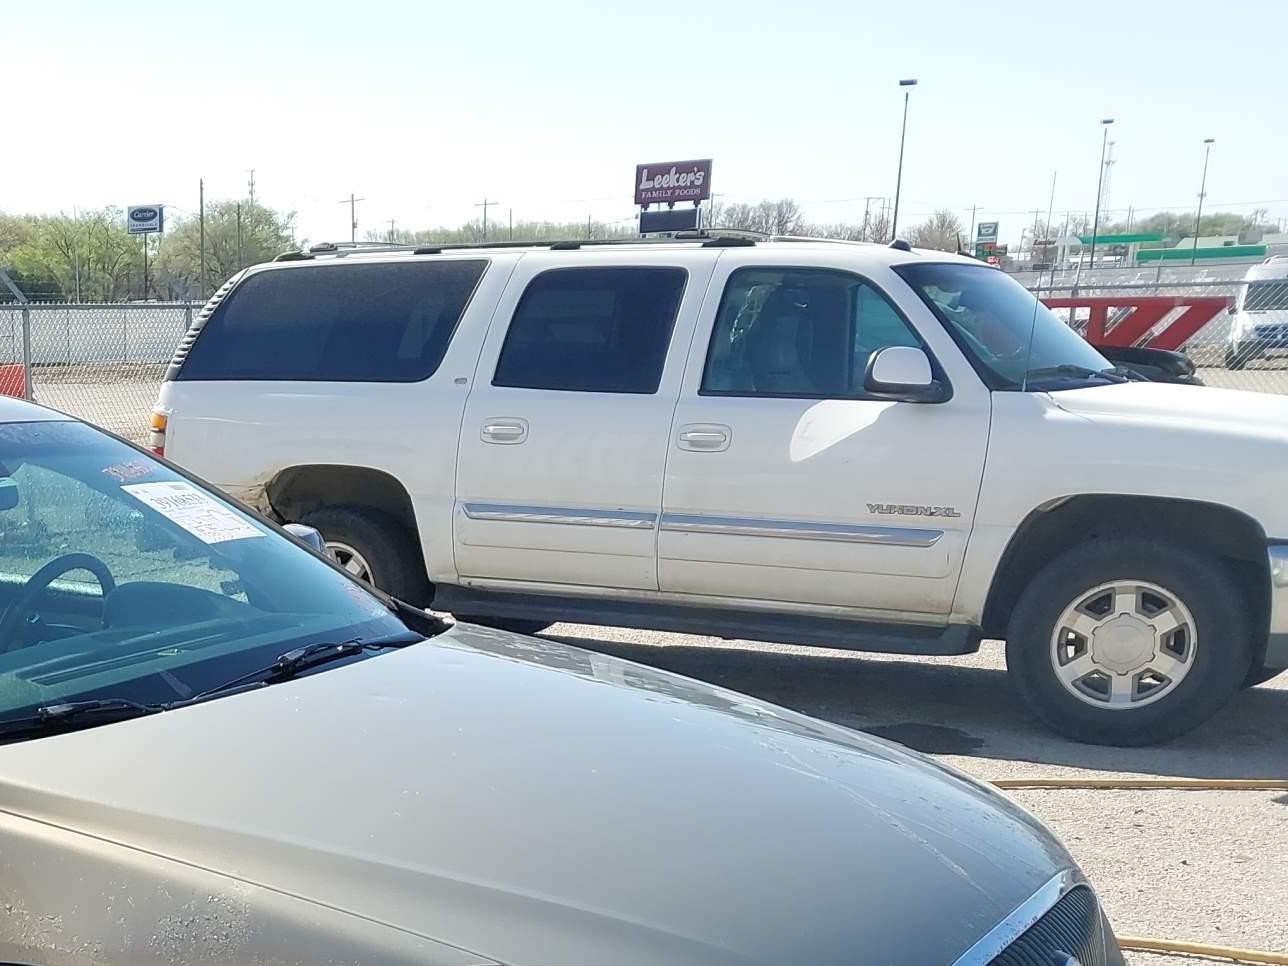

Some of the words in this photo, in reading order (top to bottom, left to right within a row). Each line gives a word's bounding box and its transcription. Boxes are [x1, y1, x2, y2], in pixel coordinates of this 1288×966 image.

[639, 166, 705, 190] Leeker's
[642, 190, 673, 198] FAMILY
[674, 188, 701, 196] FOODS
[866, 503, 931, 516] YUKON
[931, 506, 961, 518] XL
